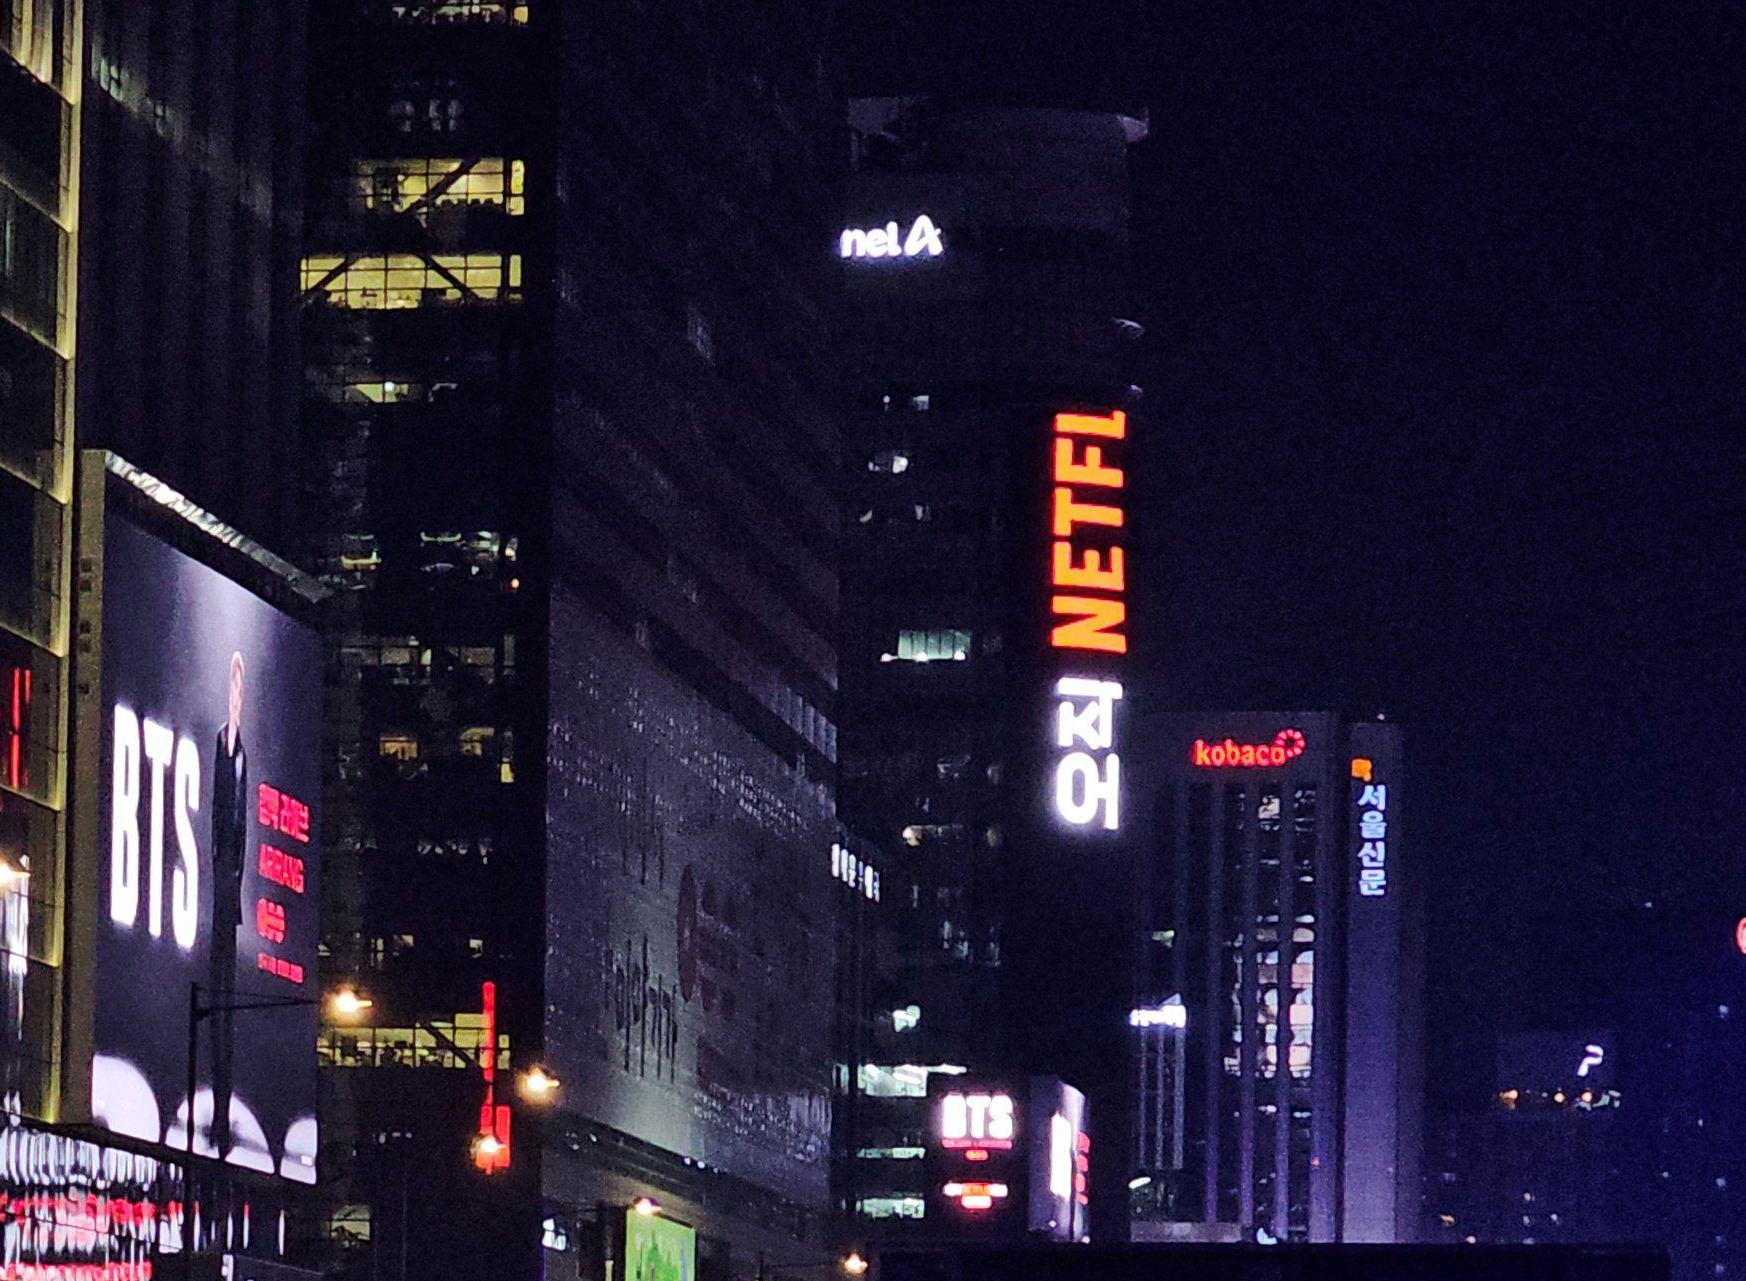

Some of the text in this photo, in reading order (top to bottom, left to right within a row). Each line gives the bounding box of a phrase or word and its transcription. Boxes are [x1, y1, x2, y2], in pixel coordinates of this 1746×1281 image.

[1052, 410, 1127, 830] 오직 NETFL
[110, 704, 200, 950] BTS
[1193, 738, 1286, 767] kobaco
[1357, 784, 1388, 896] 서울신문
